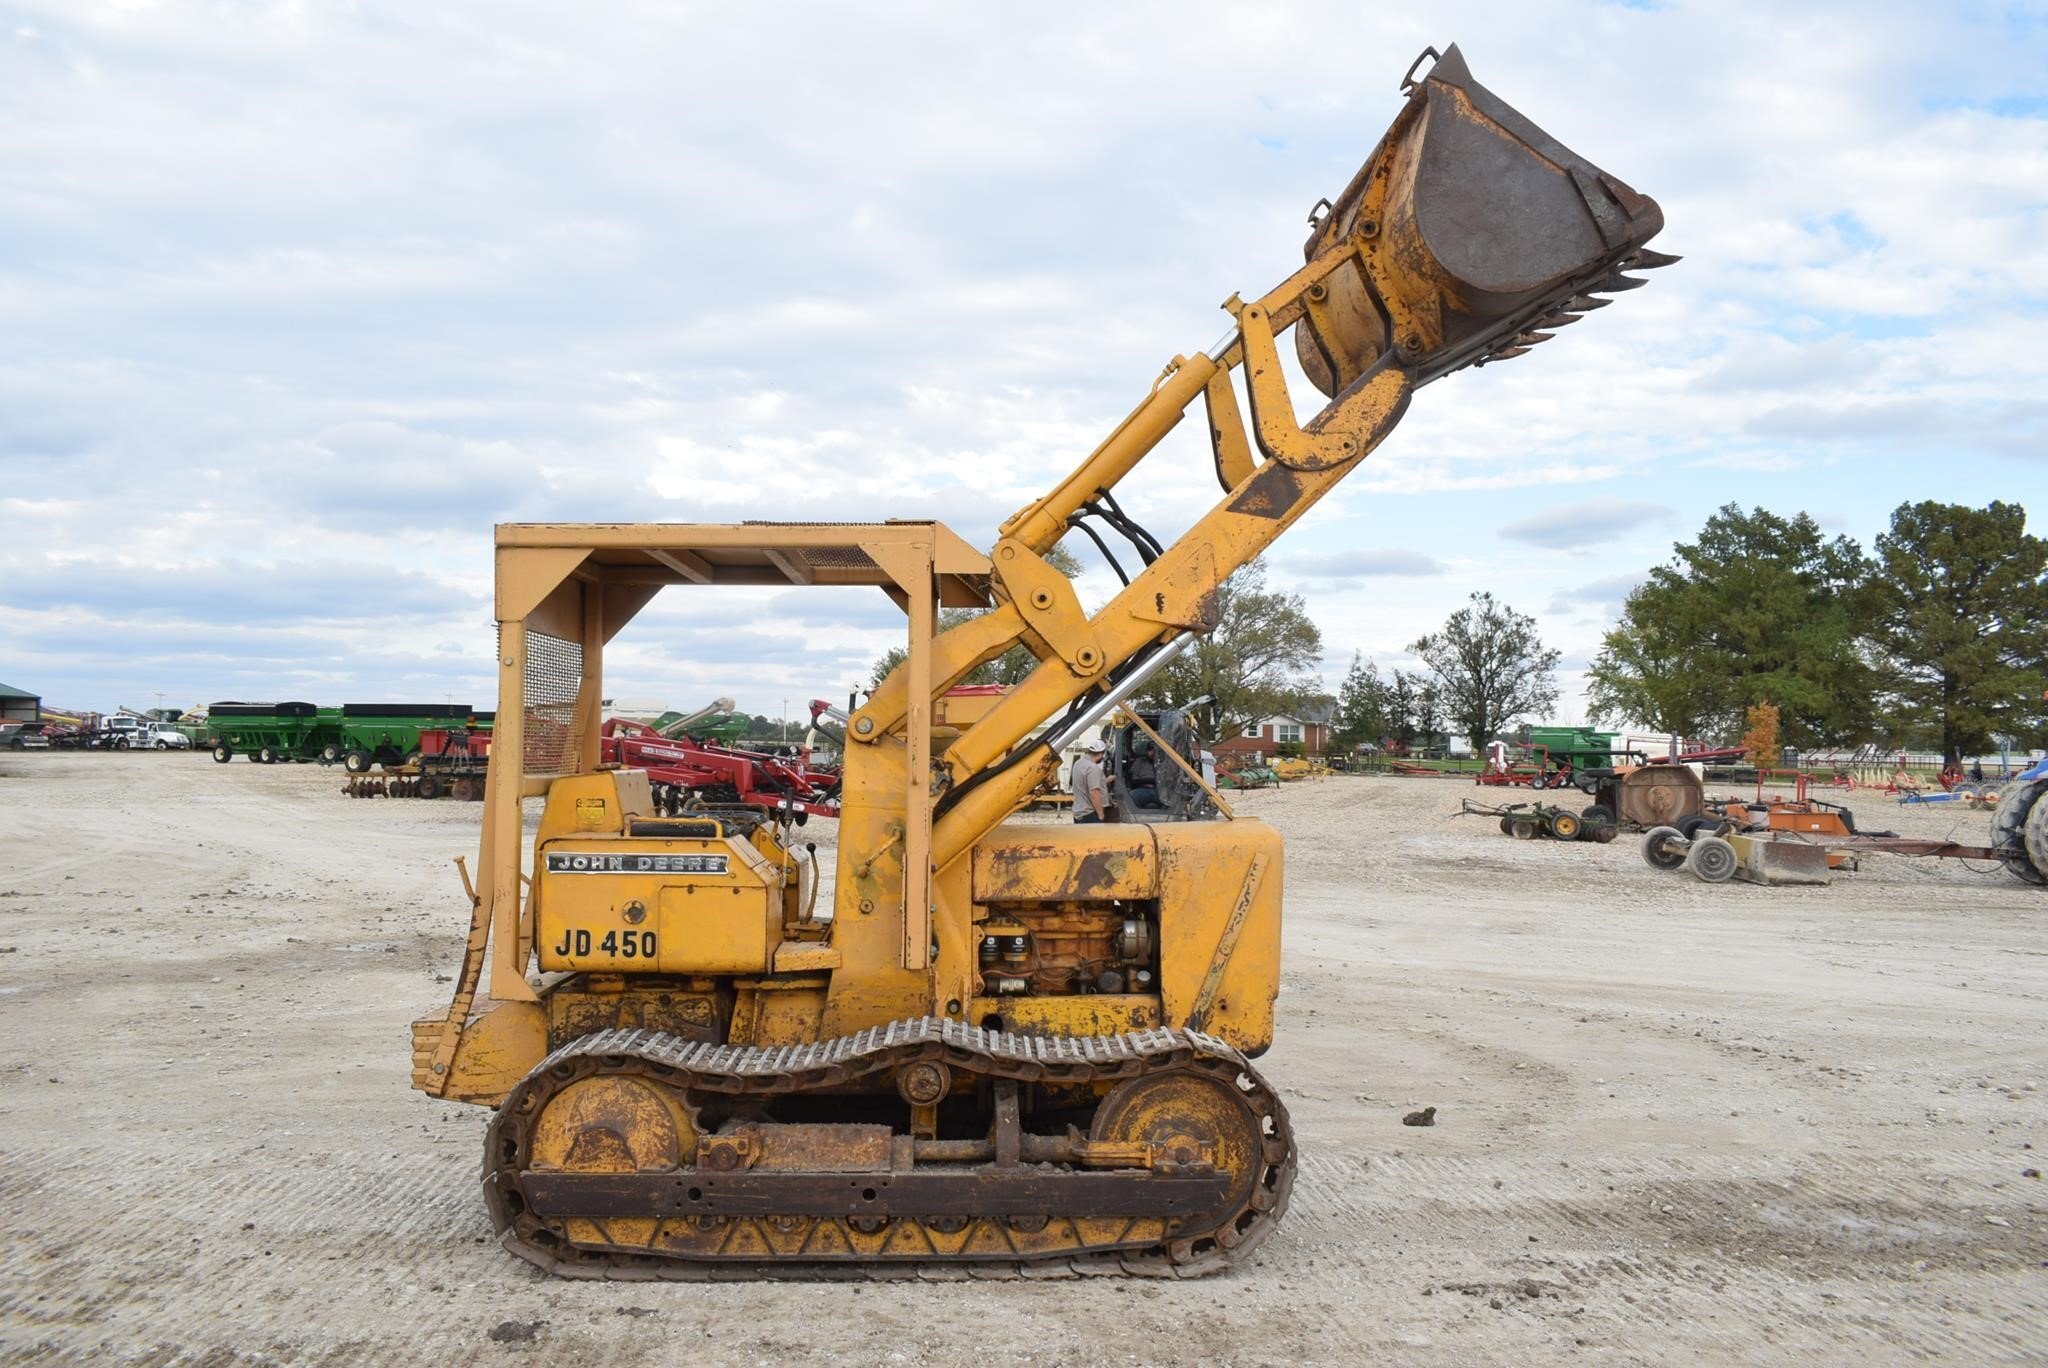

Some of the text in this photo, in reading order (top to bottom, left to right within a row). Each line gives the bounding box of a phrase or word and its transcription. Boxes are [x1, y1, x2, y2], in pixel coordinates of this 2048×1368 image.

[558, 856, 720, 871] JOHN DEERE
[555, 929, 657, 959] JD 450
